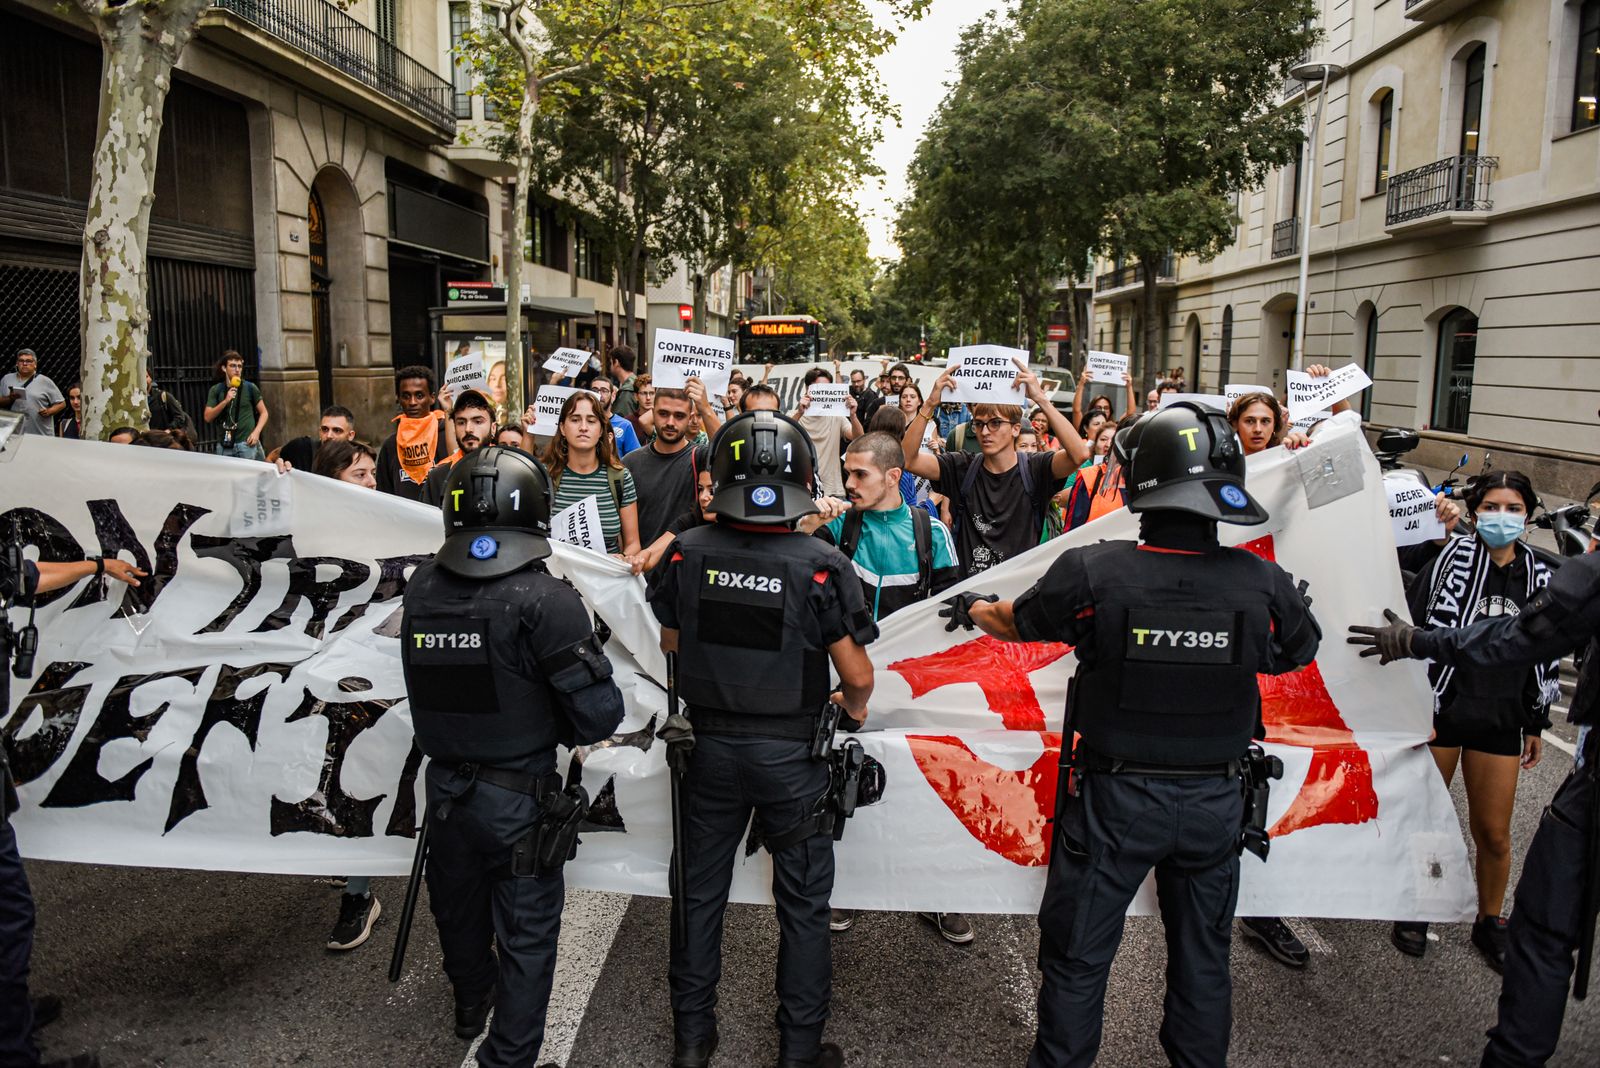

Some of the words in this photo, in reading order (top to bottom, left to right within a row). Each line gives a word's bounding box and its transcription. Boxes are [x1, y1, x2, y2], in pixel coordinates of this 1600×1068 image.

[561, 351, 581, 360] DECRET
[658, 341, 732, 360] CONTRACTES
[452, 362, 473, 375] DECRET
[662, 354, 725, 371] INDEFINITS
[963, 356, 1009, 367] DECRET
[1090, 357, 1127, 367] CONTRACTES
[1092, 363, 1124, 372] INDEFINITS
[683, 368, 701, 378] JA!
[1290, 368, 1357, 392] CONTRACTES
[974, 381, 993, 391] JA!
[1294, 374, 1355, 402] INDEFINITS
[1319, 390, 1337, 402] JA!
[1178, 427, 1200, 452] T
[730, 439, 745, 461] T
[782, 441, 793, 463] 1
[451, 489, 464, 512] T
[509, 489, 521, 511] 1
[1395, 489, 1426, 504] DECRET
[1404, 519, 1420, 531] JA!
[706, 569, 783, 594] T9X426
[413, 632, 482, 649] T9T128
[1132, 628, 1229, 648] T7Y395
